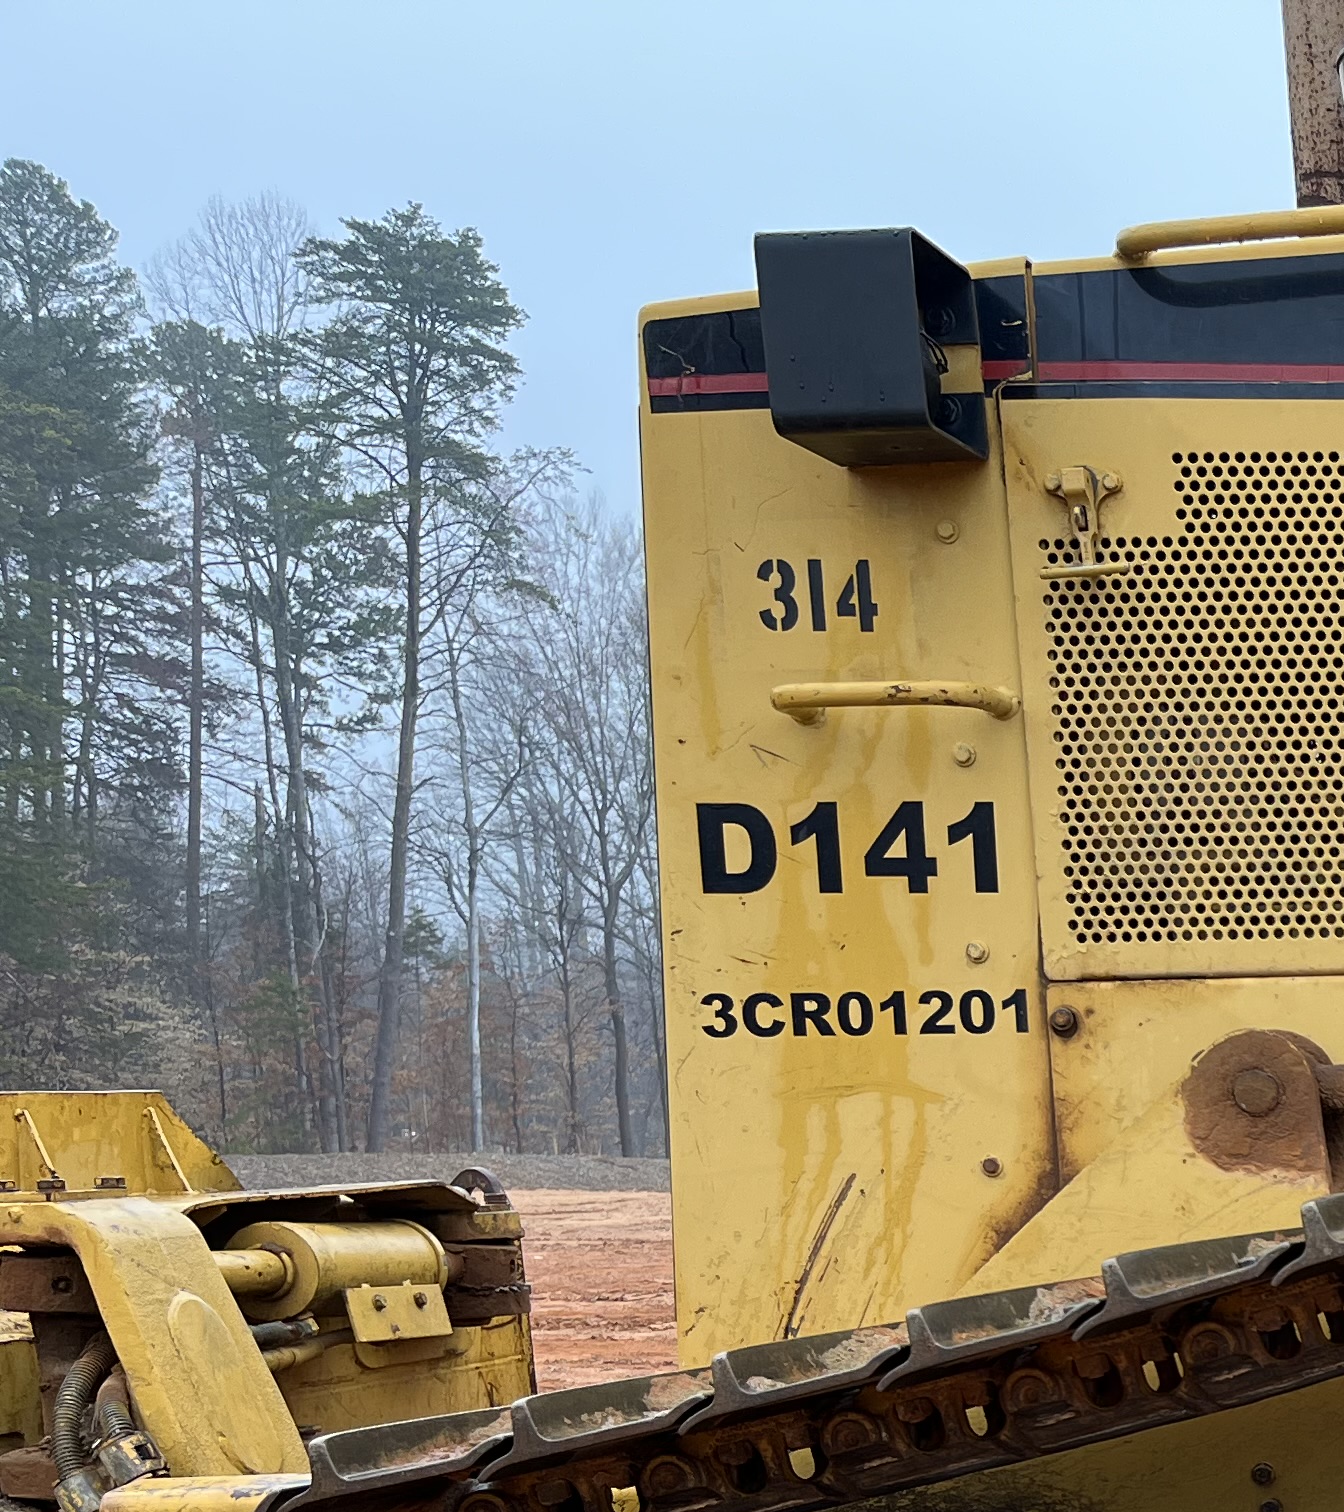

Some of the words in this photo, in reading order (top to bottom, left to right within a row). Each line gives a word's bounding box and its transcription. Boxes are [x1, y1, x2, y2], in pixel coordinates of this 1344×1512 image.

[756, 558, 879, 633] 314
[695, 800, 999, 894] D141
[700, 988, 1029, 1038] 3CR01201
